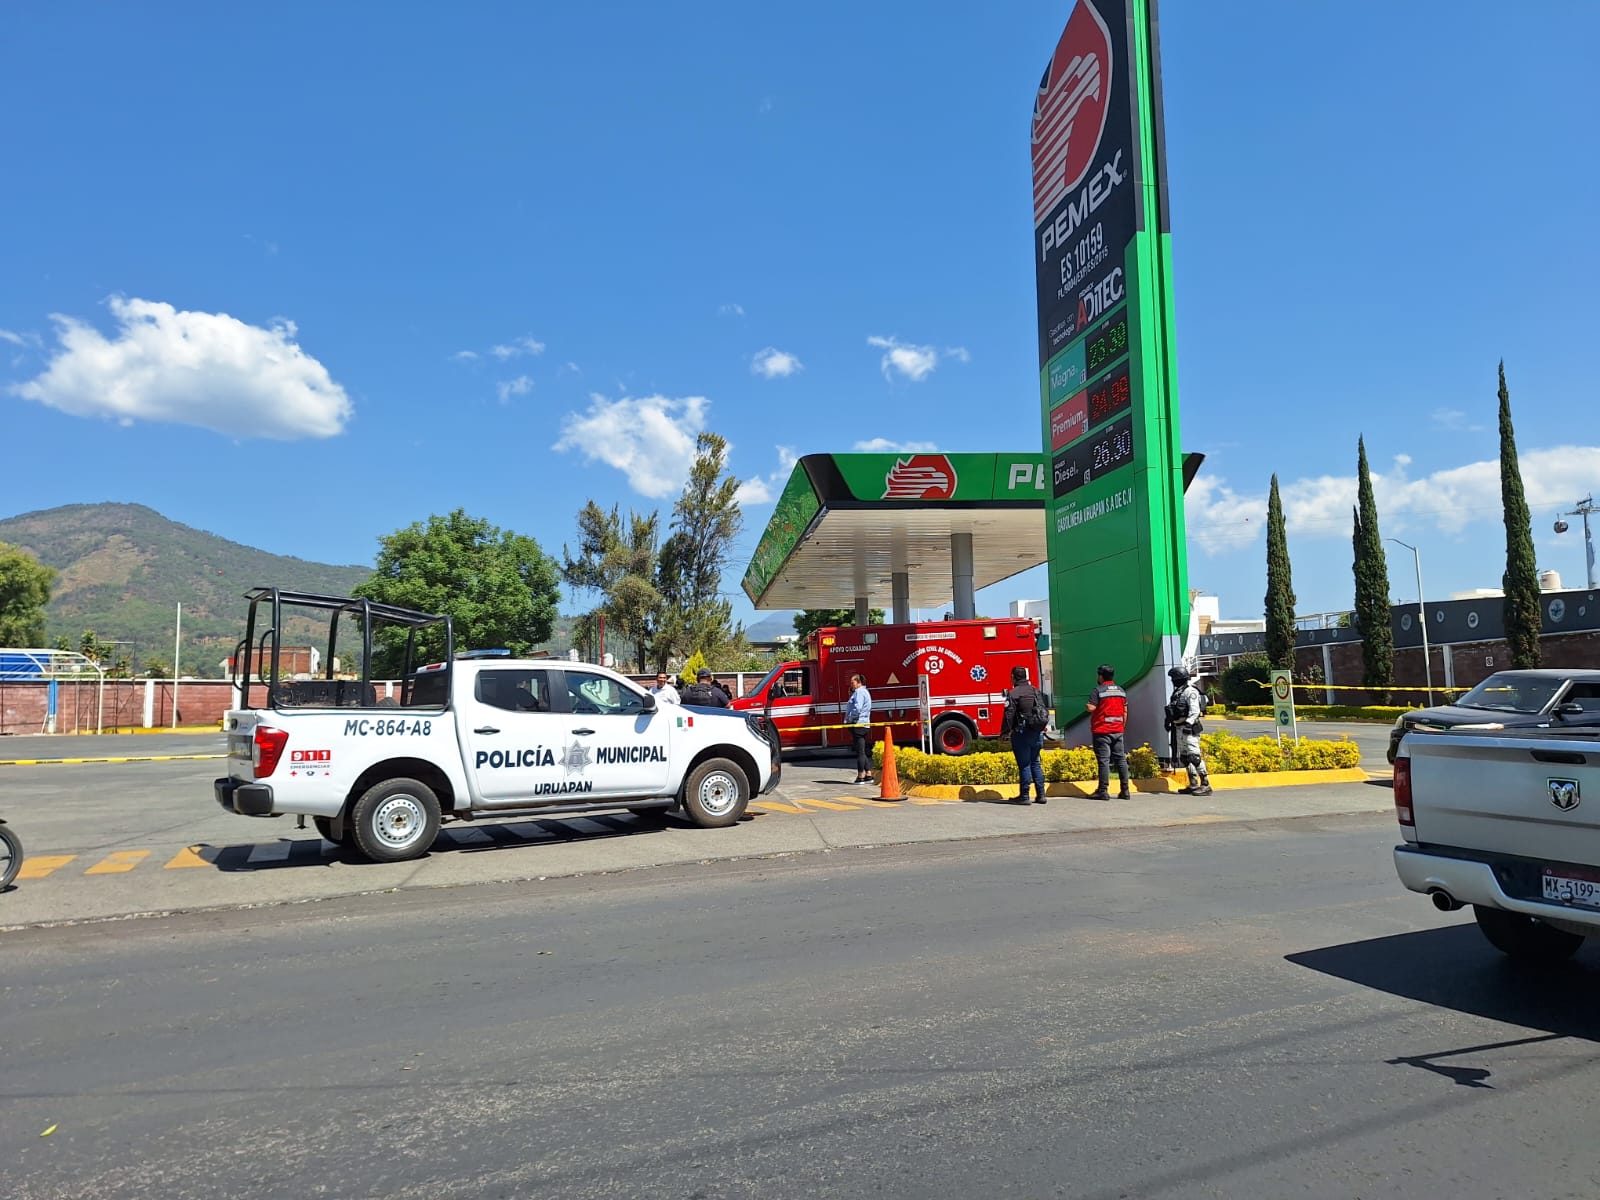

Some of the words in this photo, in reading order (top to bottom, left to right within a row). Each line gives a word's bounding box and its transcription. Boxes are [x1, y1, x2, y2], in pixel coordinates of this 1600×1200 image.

[1041, 149, 1122, 263] PEMEX
[1060, 252, 1072, 285] ES
[1074, 222, 1103, 270] 10159
[1051, 365, 1076, 388] Magna
[1052, 410, 1083, 438] Premium
[1093, 429, 1131, 470] 26.30
[1055, 461, 1076, 485] Diesel
[343, 719, 432, 737] MC-864-A8
[292, 750, 329, 761] 911
[475, 745, 555, 769] POLICÍA
[596, 745, 667, 765] MUNICIPAL
[534, 780, 593, 795] URUAPAN
